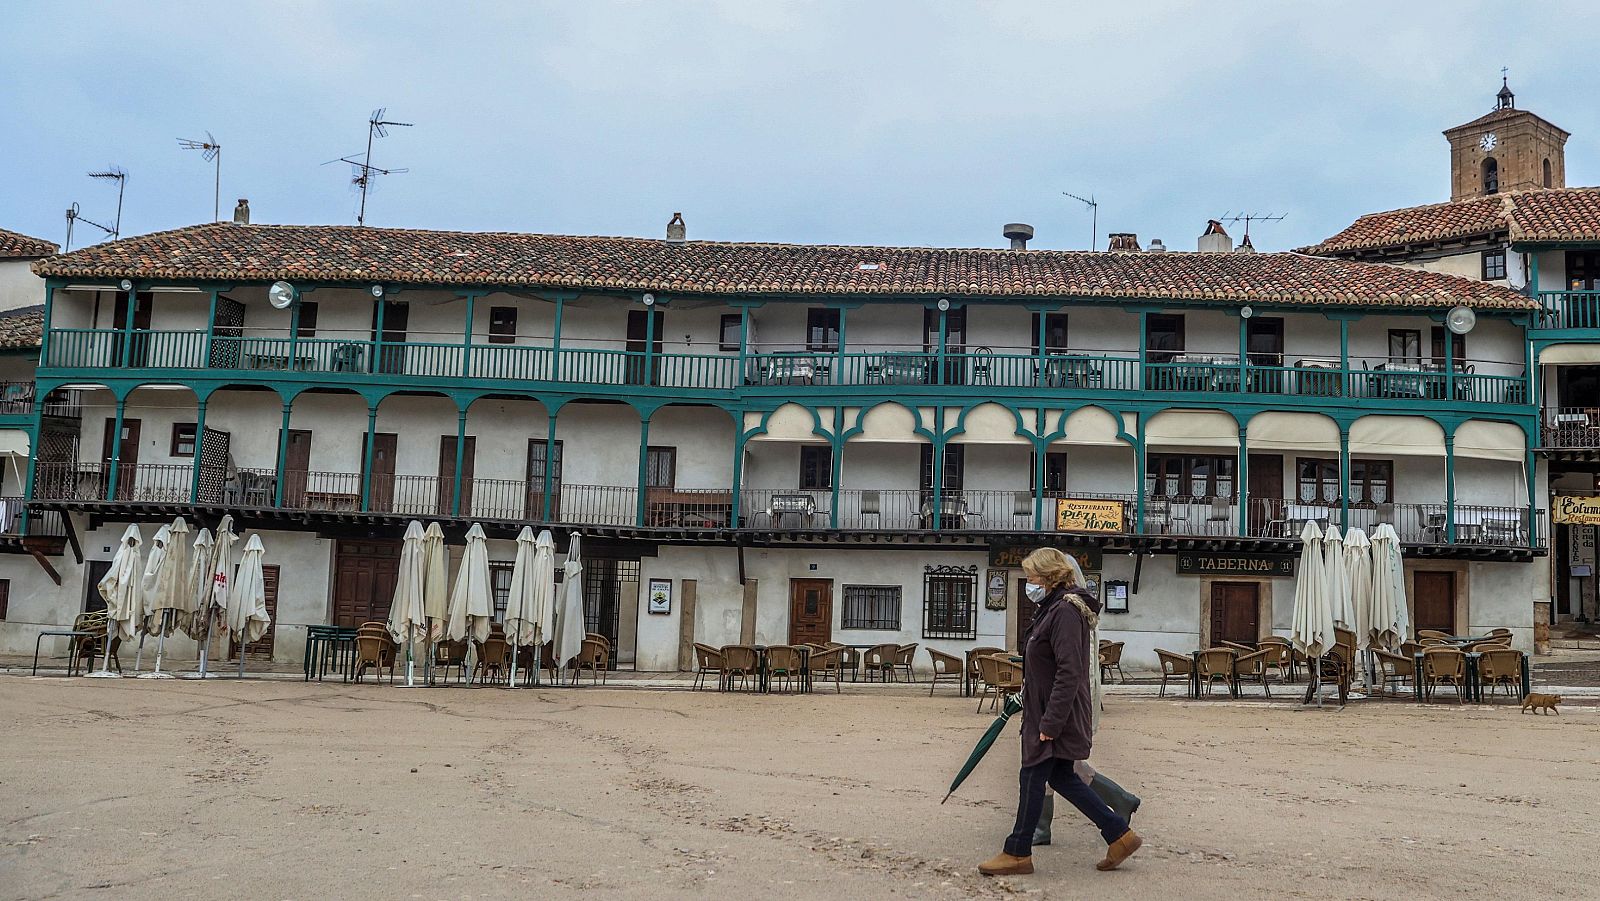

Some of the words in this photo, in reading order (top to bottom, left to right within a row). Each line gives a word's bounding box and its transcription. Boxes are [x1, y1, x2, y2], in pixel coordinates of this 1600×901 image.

[1561, 496, 1575, 506] La
[1061, 510, 1097, 520] PLAZA
[1084, 519, 1119, 531] MAYOR
[1199, 557, 1269, 571] TABERNA
